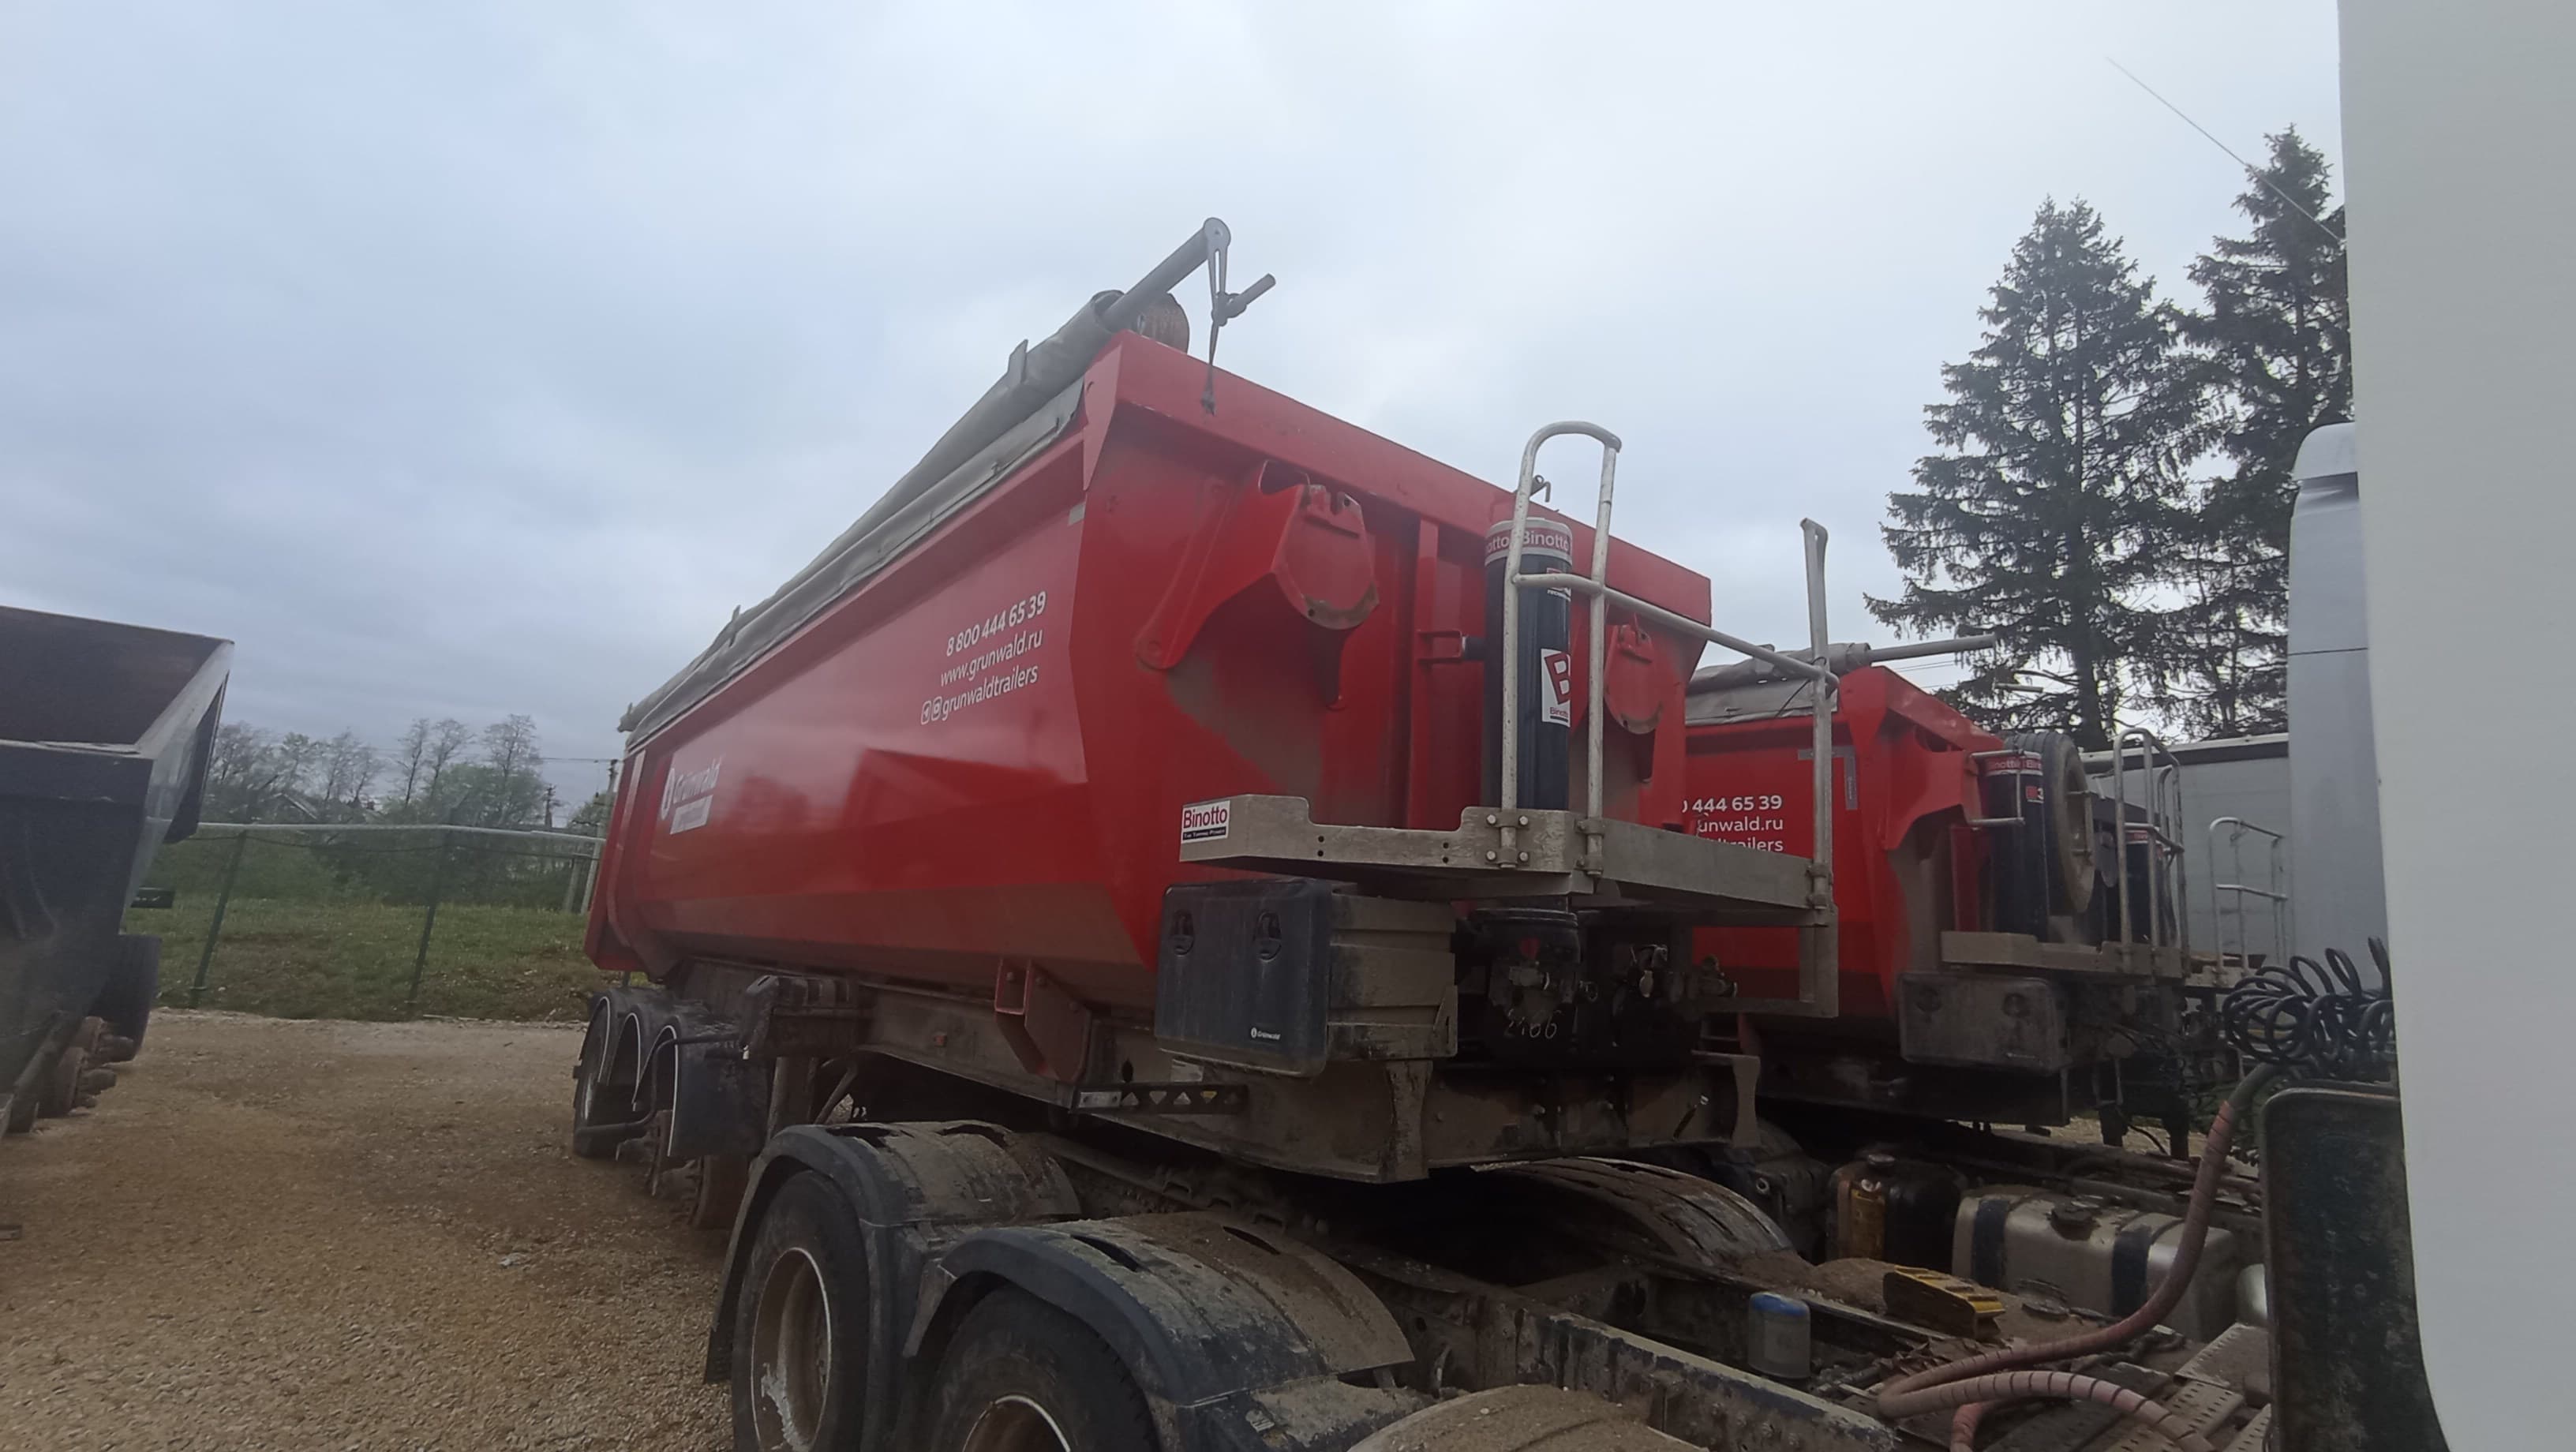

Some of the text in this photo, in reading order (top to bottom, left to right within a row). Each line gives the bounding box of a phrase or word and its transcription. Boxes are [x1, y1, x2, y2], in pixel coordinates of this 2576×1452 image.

[946, 590, 1046, 657] 8 800 444 65 39
[941, 629, 1043, 687] www.grunwald.ru
[942, 664, 1039, 721] grunwaldtrailers
[1184, 806, 1227, 829] Binotto
[1691, 798, 1728, 813] 444
[1732, 795, 1754, 811] 65
[1758, 795, 1782, 810] 39
